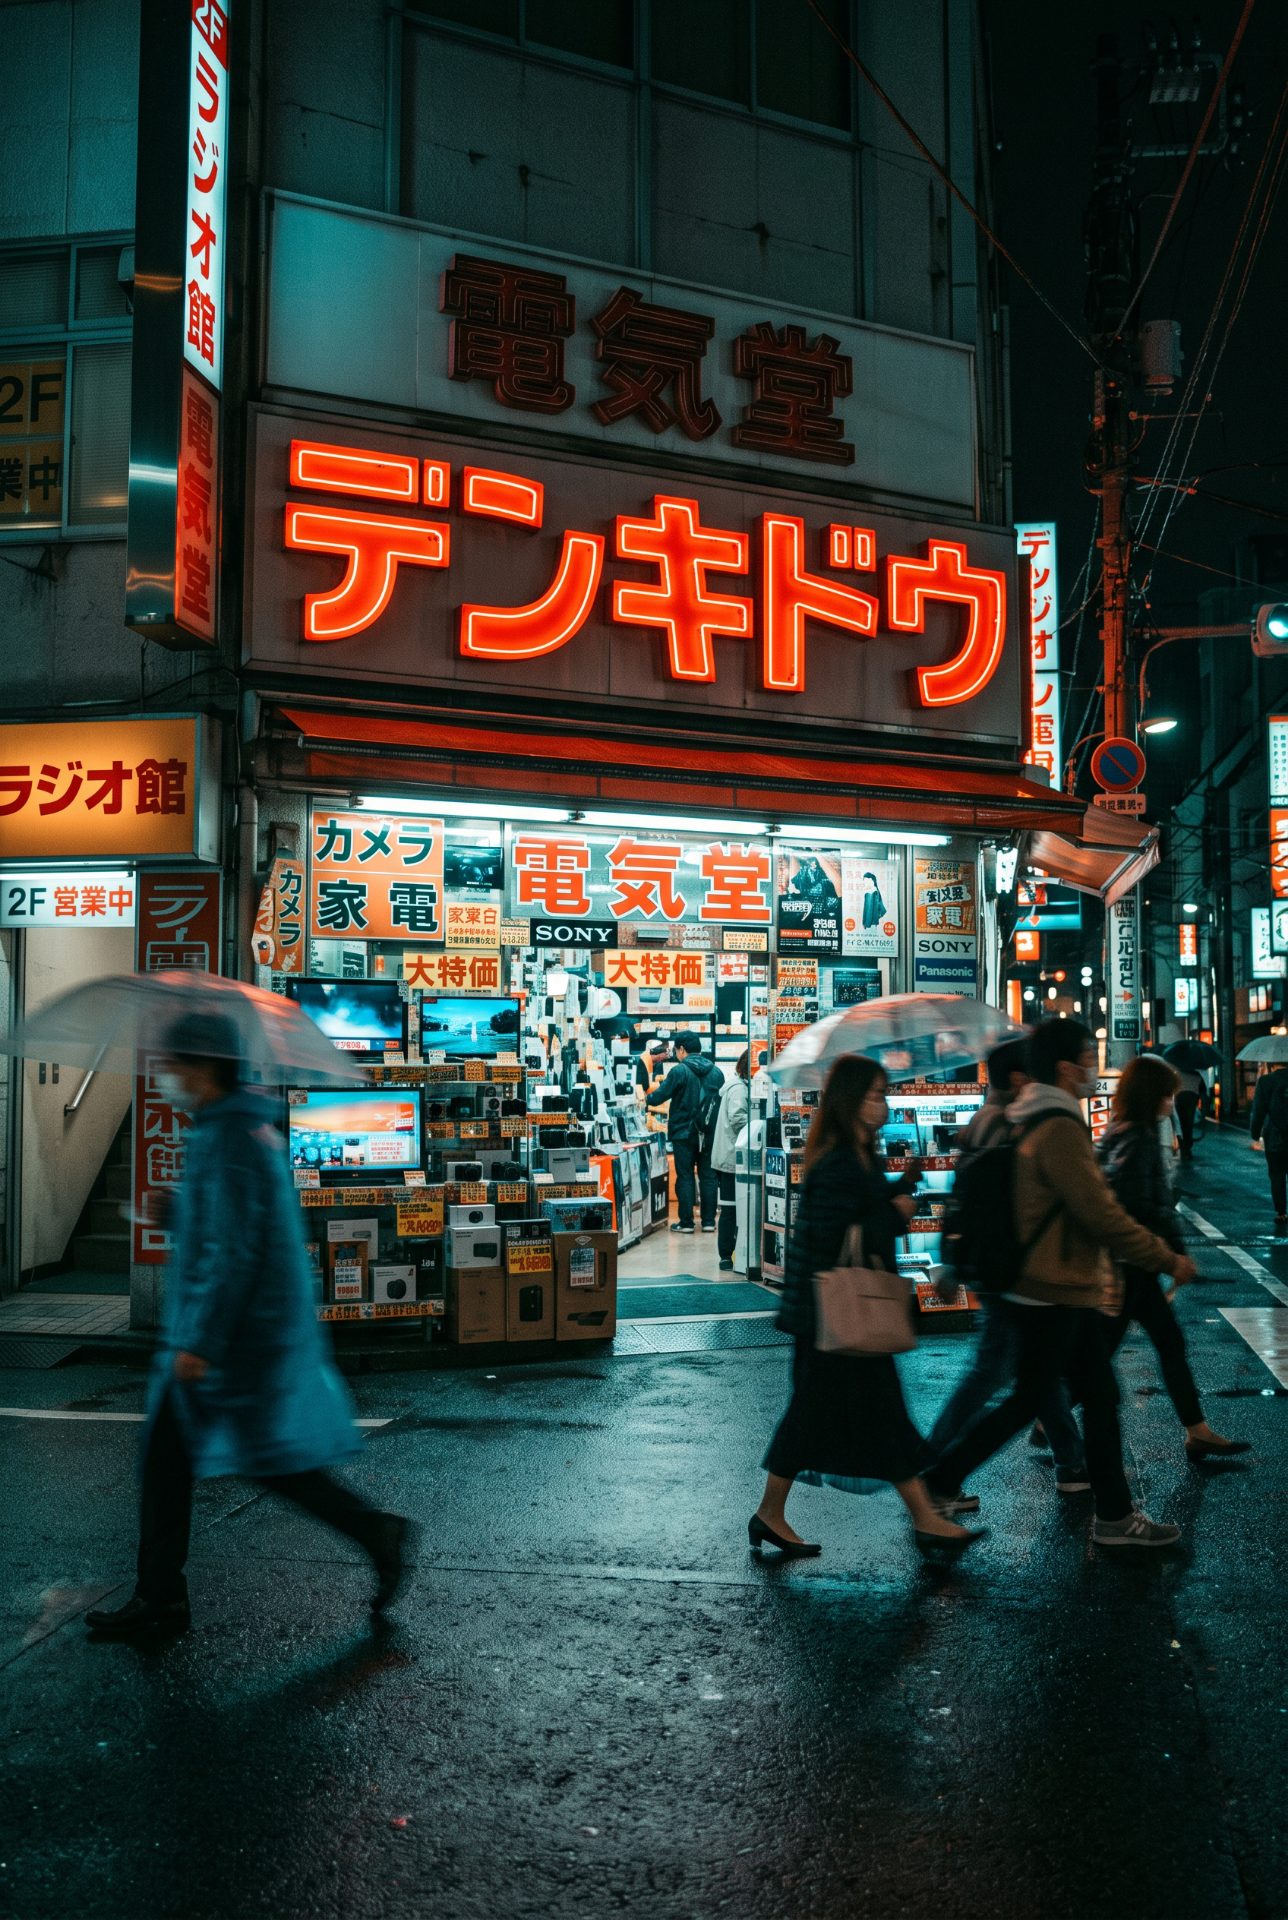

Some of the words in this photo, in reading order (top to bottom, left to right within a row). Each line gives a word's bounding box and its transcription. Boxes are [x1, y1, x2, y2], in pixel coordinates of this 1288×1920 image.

[187, 50, 220, 368] ラジオ館
[439, 253, 856, 467] 電気堂
[0, 373, 62, 423] 2F
[284, 439, 1007, 708] デンキドウ
[0, 758, 188, 817] ラジオ館
[314, 818, 434, 866] カメラ
[8, 887, 47, 916] 2F
[54, 885, 133, 917] 営業中
[513, 834, 771, 921] 電気堂
[278, 869, 303, 947] カメラ
[535, 925, 613, 942] SONY
[918, 939, 974, 953] SONY
[405, 955, 498, 988] 大特価
[607, 952, 702, 985] 大特価
[919, 964, 974, 977] Panasonic
